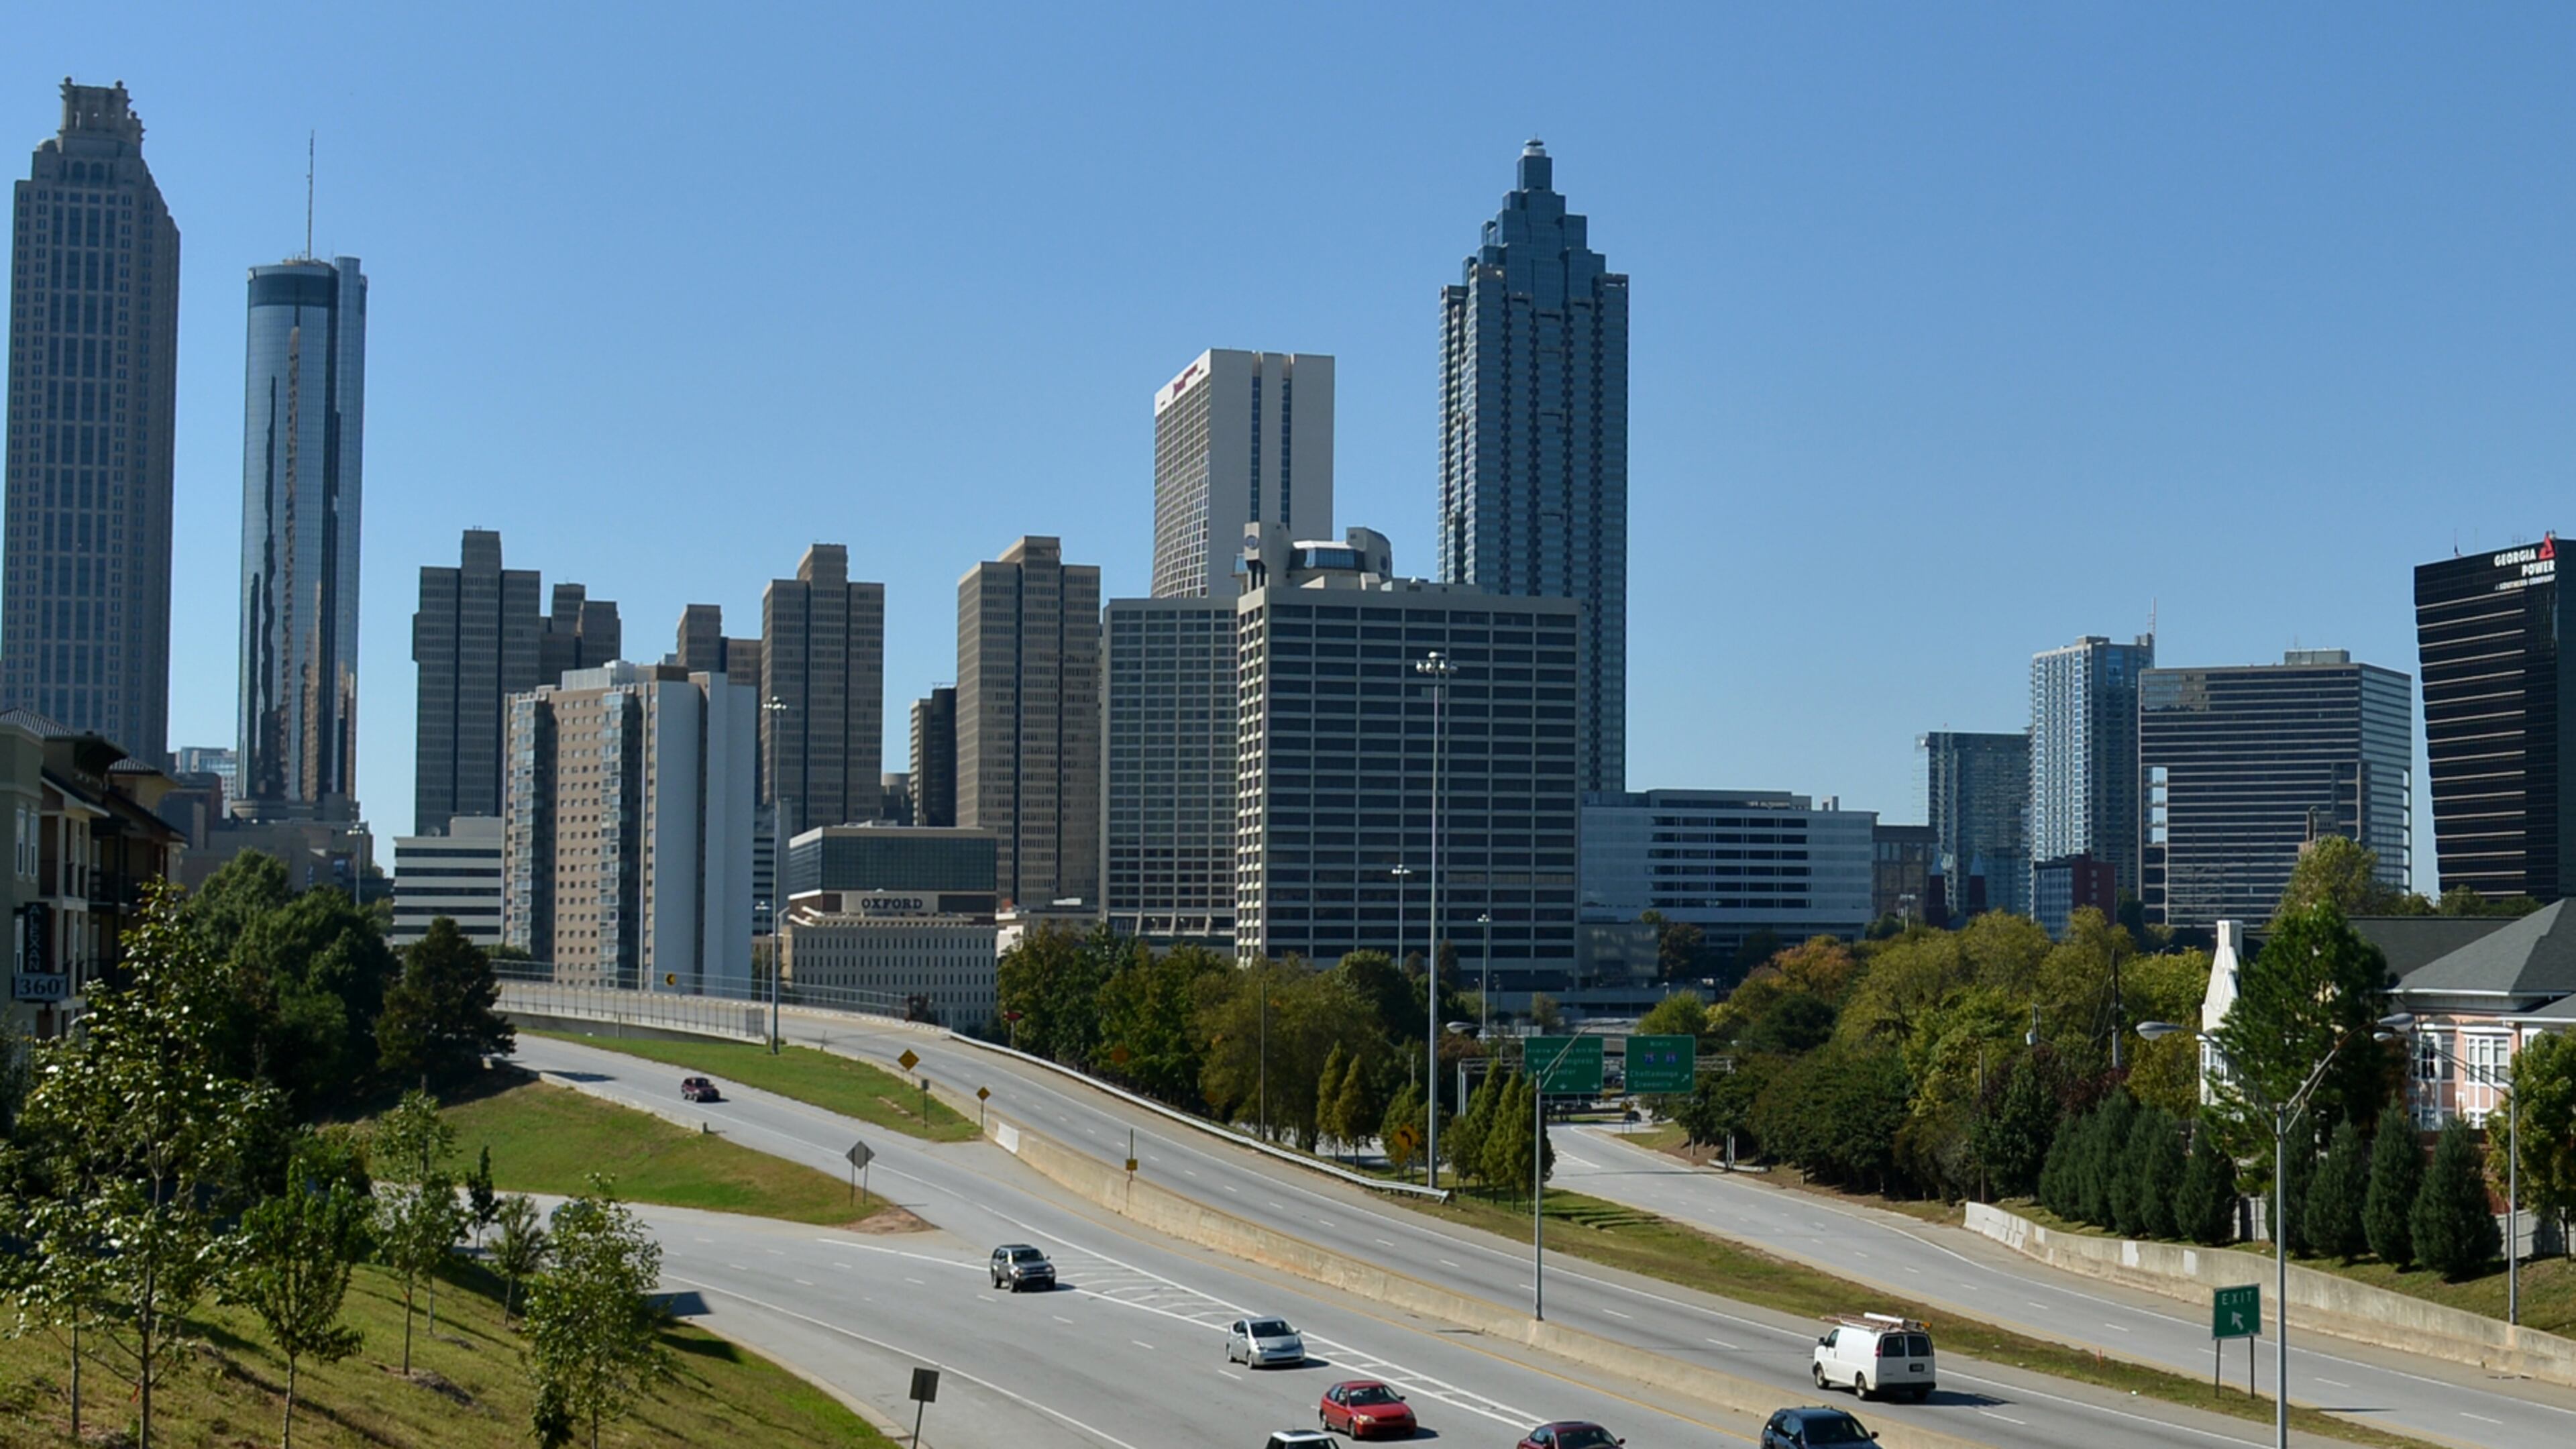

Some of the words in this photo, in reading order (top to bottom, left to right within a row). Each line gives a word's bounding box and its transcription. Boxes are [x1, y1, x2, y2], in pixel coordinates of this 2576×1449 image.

[2494, 548, 2536, 566] GEORGIA
[2522, 559, 2555, 577] POWER
[861, 898, 923, 910] OXFORD
[28, 904, 41, 971] ALEXAN
[2221, 1291, 2253, 1305] EXIT
